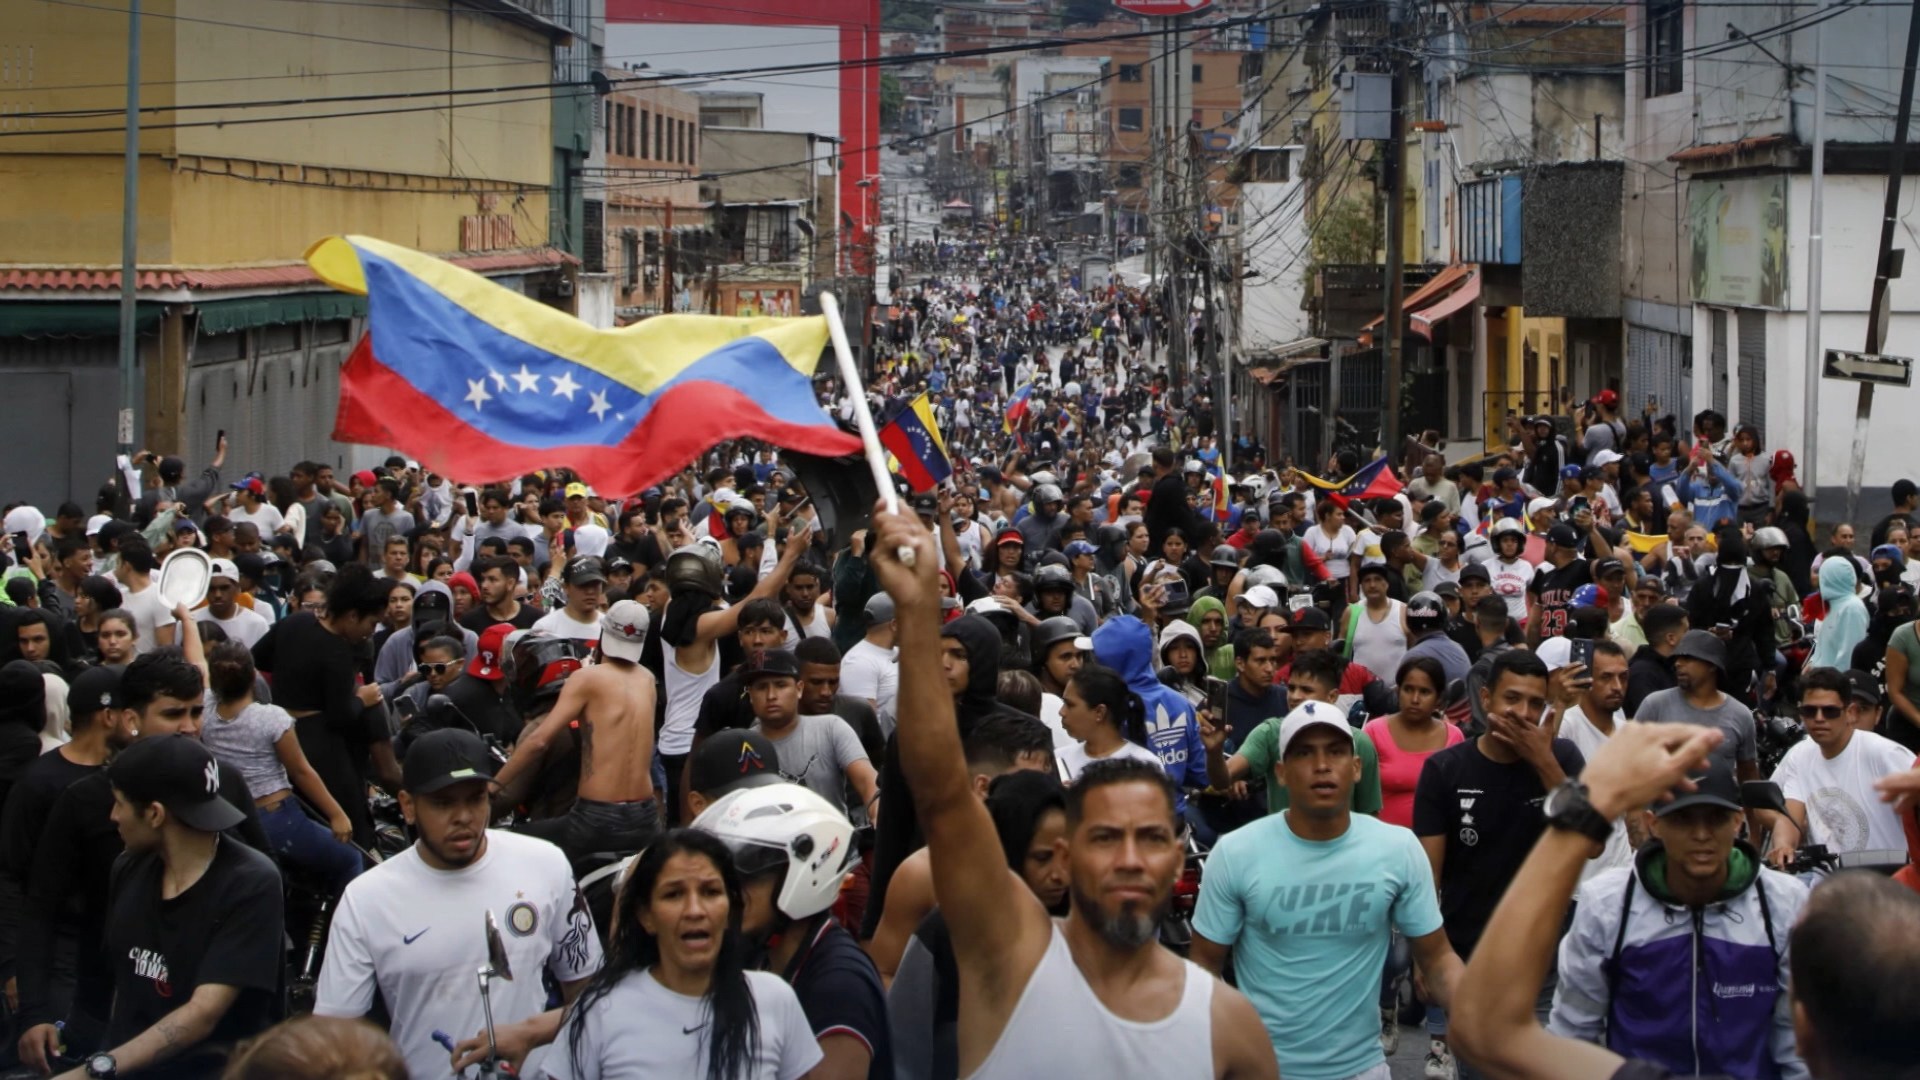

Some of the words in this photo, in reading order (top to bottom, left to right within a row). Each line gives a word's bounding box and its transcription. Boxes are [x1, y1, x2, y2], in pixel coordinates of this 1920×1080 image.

[1541, 609, 1567, 637] 23
[482, 650, 494, 665] P
[1263, 882, 1376, 935] NIKE
